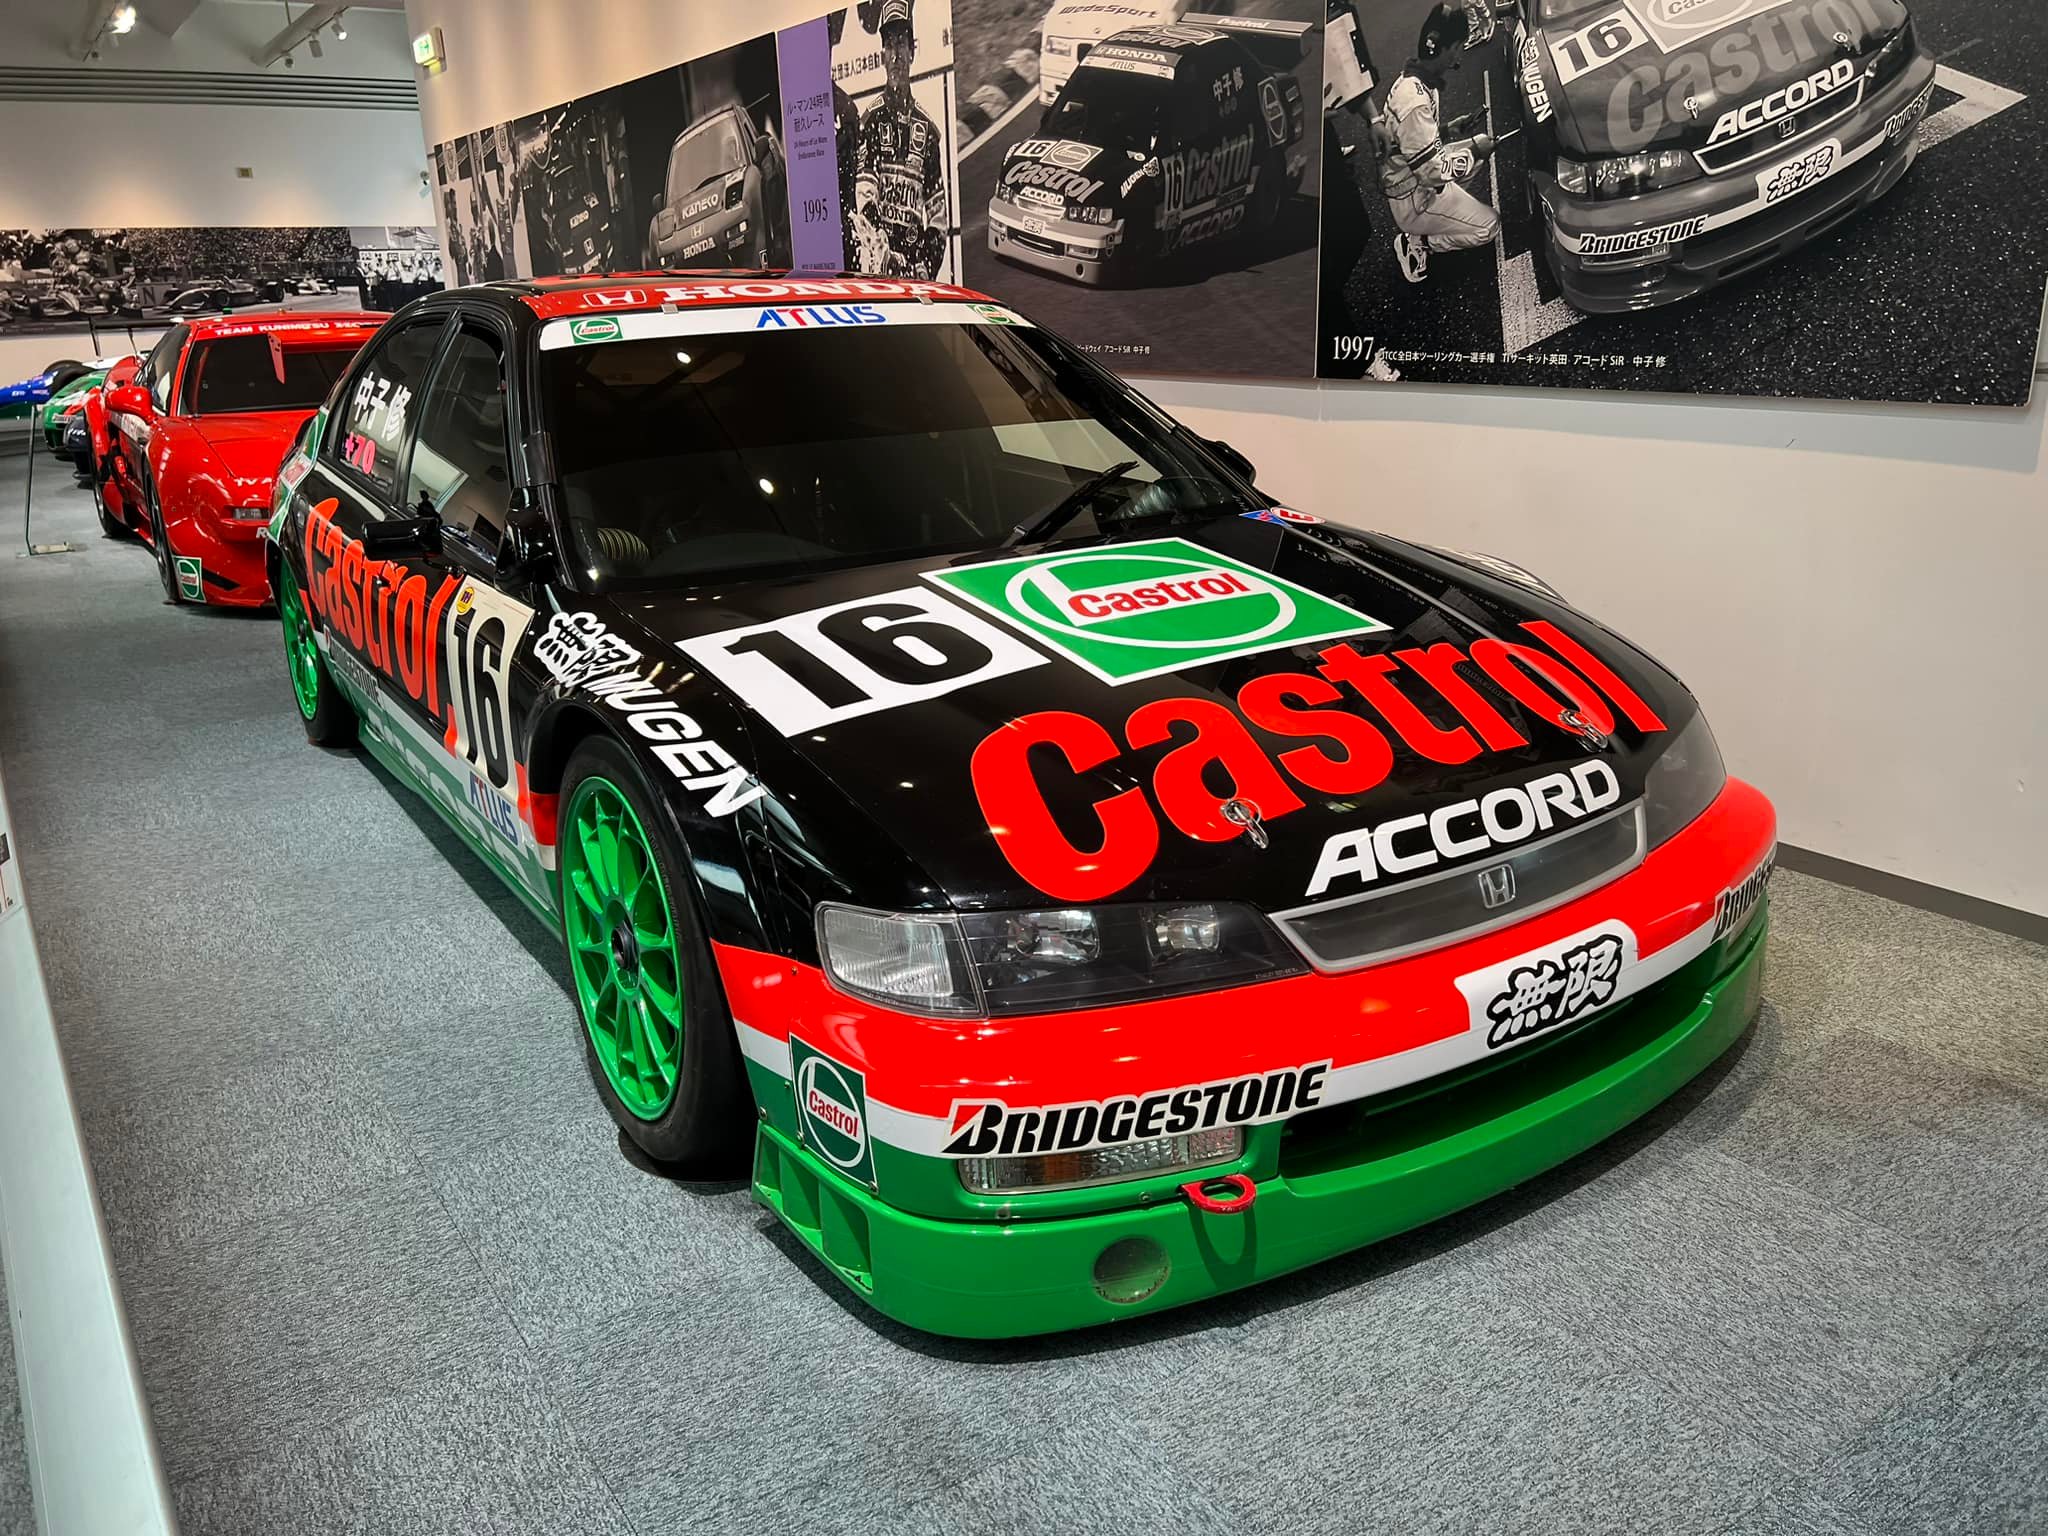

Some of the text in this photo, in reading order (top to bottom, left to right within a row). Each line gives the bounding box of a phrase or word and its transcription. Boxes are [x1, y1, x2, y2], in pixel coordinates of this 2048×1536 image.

[1105, 47, 1167, 62] HONDA
[1558, 18, 1635, 74] 16
[1706, 59, 1855, 143] ACCORD
[1026, 142, 1050, 154] 16
[1004, 161, 1104, 203] Castrol
[1019, 186, 1065, 205] ACCORD
[803, 199, 828, 223] 1995
[683, 237, 716, 260] HONDA
[1579, 215, 1707, 255] BRIDGESTONE
[656, 281, 960, 301] HONDA
[215, 327, 253, 336] TEAM
[756, 306, 887, 328] ATLUS
[1333, 336, 1374, 360] 1997
[305, 497, 464, 718] Castrol
[1067, 572, 1250, 619] Castrol
[723, 603, 993, 710] 16
[454, 607, 510, 789] 16
[582, 671, 766, 818] MUGEN
[970, 620, 1668, 901] Castrol
[470, 770, 519, 846] ATLUS
[1305, 758, 1621, 897] ACCORD
[1487, 934, 1623, 1050] 無限
[809, 1089, 859, 1137] Castrol
[941, 1064, 1328, 1154] BRIDGESTONE
